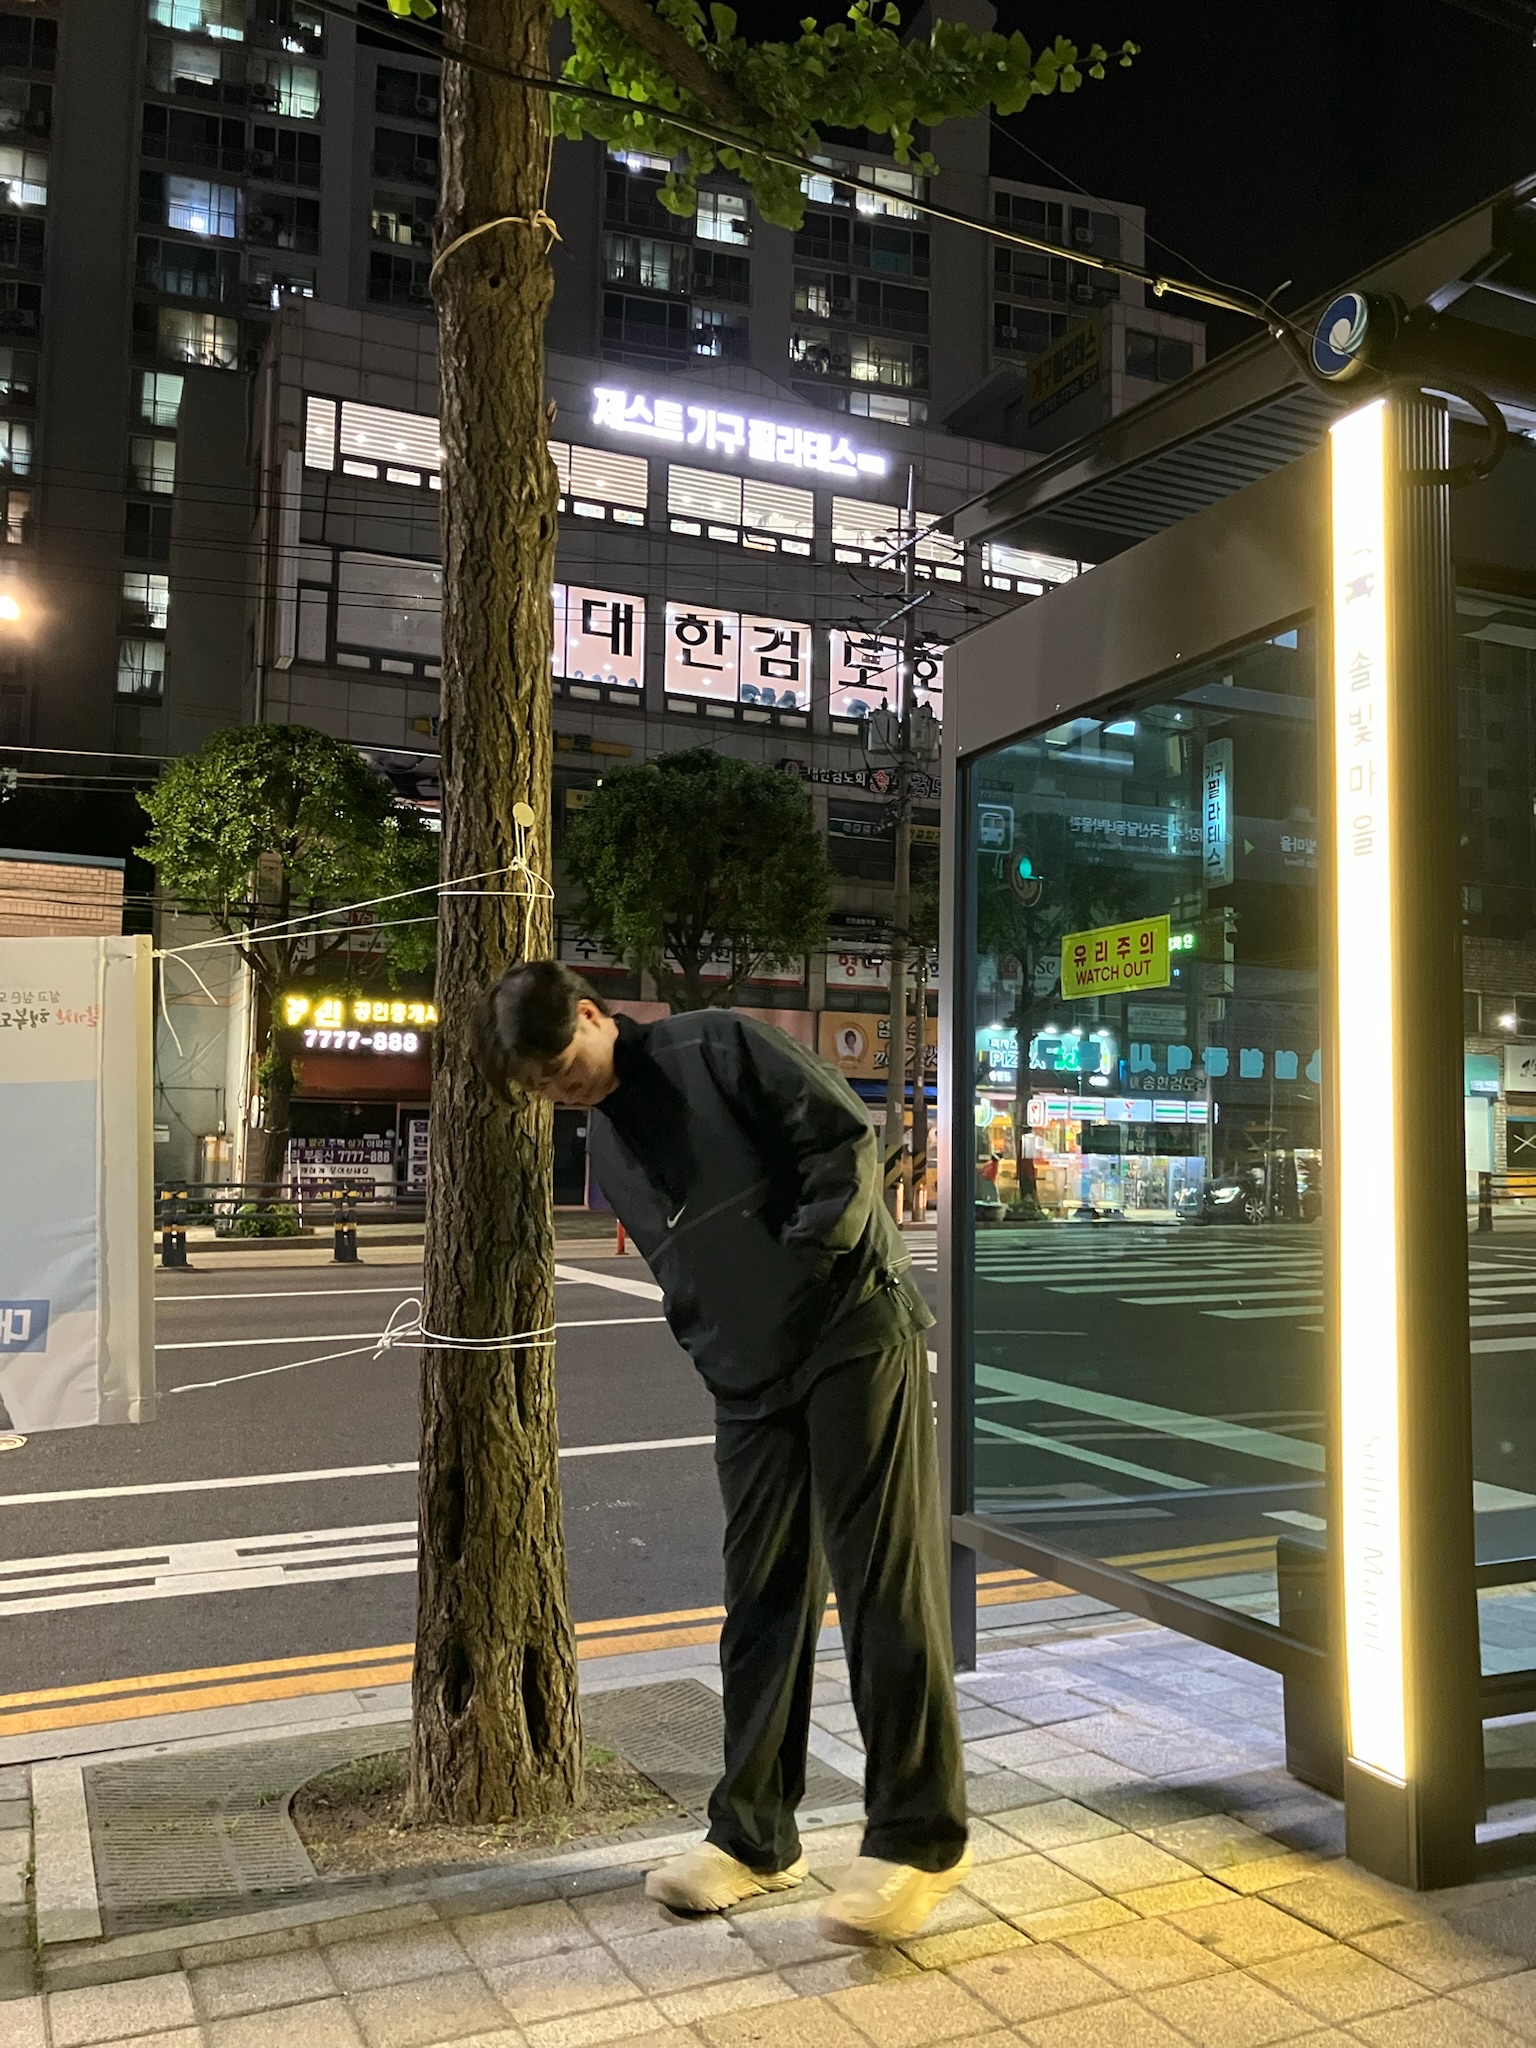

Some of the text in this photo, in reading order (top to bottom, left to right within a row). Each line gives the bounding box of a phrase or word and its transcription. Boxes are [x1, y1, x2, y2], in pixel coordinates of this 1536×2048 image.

[687, 406, 746, 456] 기구
[748, 418, 858, 478] 필라테스
[1347, 650, 1376, 857] 솔빛마을
[1204, 761, 1224, 779] 기구
[1206, 779, 1222, 867] 필라테스
[1076, 964, 1119, 986] WATCH
[1123, 959, 1152, 979] OUT
[304, 1029, 418, 1052] 7777-888
[304, 1149, 335, 1163] 부동산
[338, 1150, 390, 1163] 7777-888
